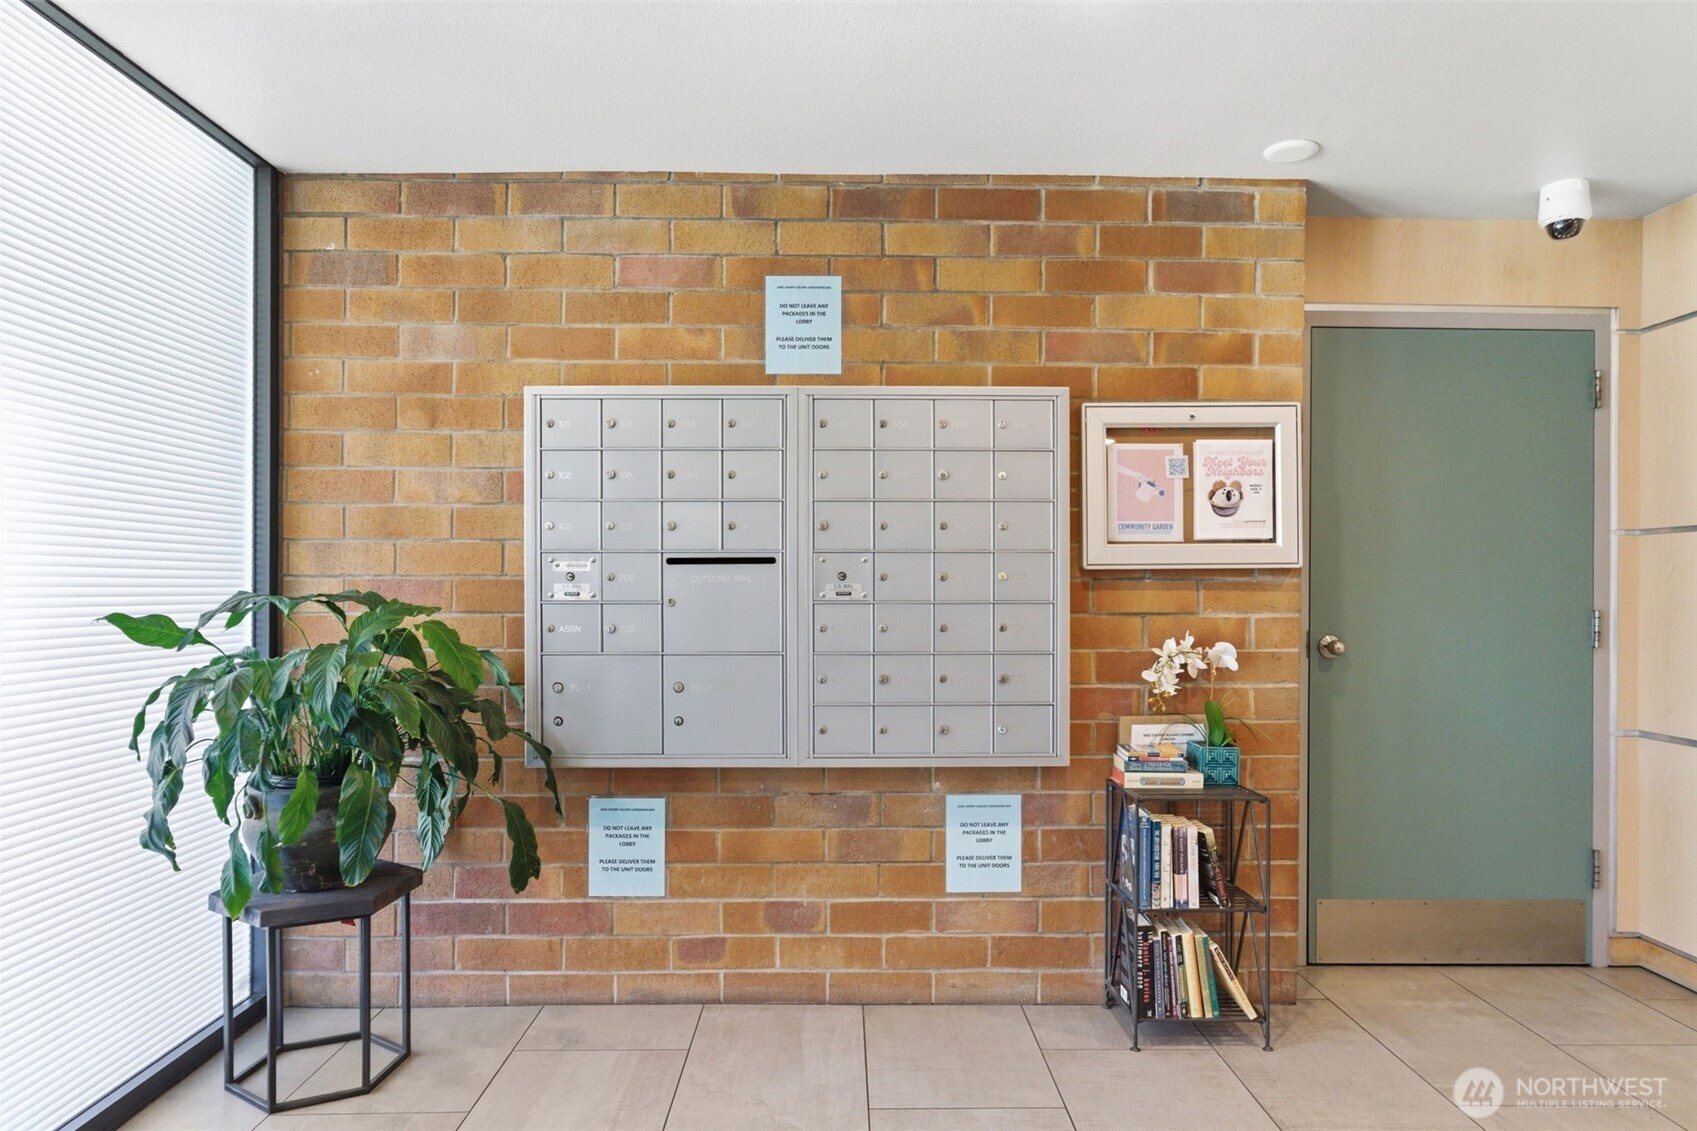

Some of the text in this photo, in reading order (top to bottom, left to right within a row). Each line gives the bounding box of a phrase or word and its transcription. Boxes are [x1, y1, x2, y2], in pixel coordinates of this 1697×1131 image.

[558, 420, 570, 428] 101
[1202, 456, 1267, 468] Meet Your
[558, 471, 572, 480] 102
[1206, 466, 1264, 480] Neighbors
[558, 624, 582, 633] ASSN
